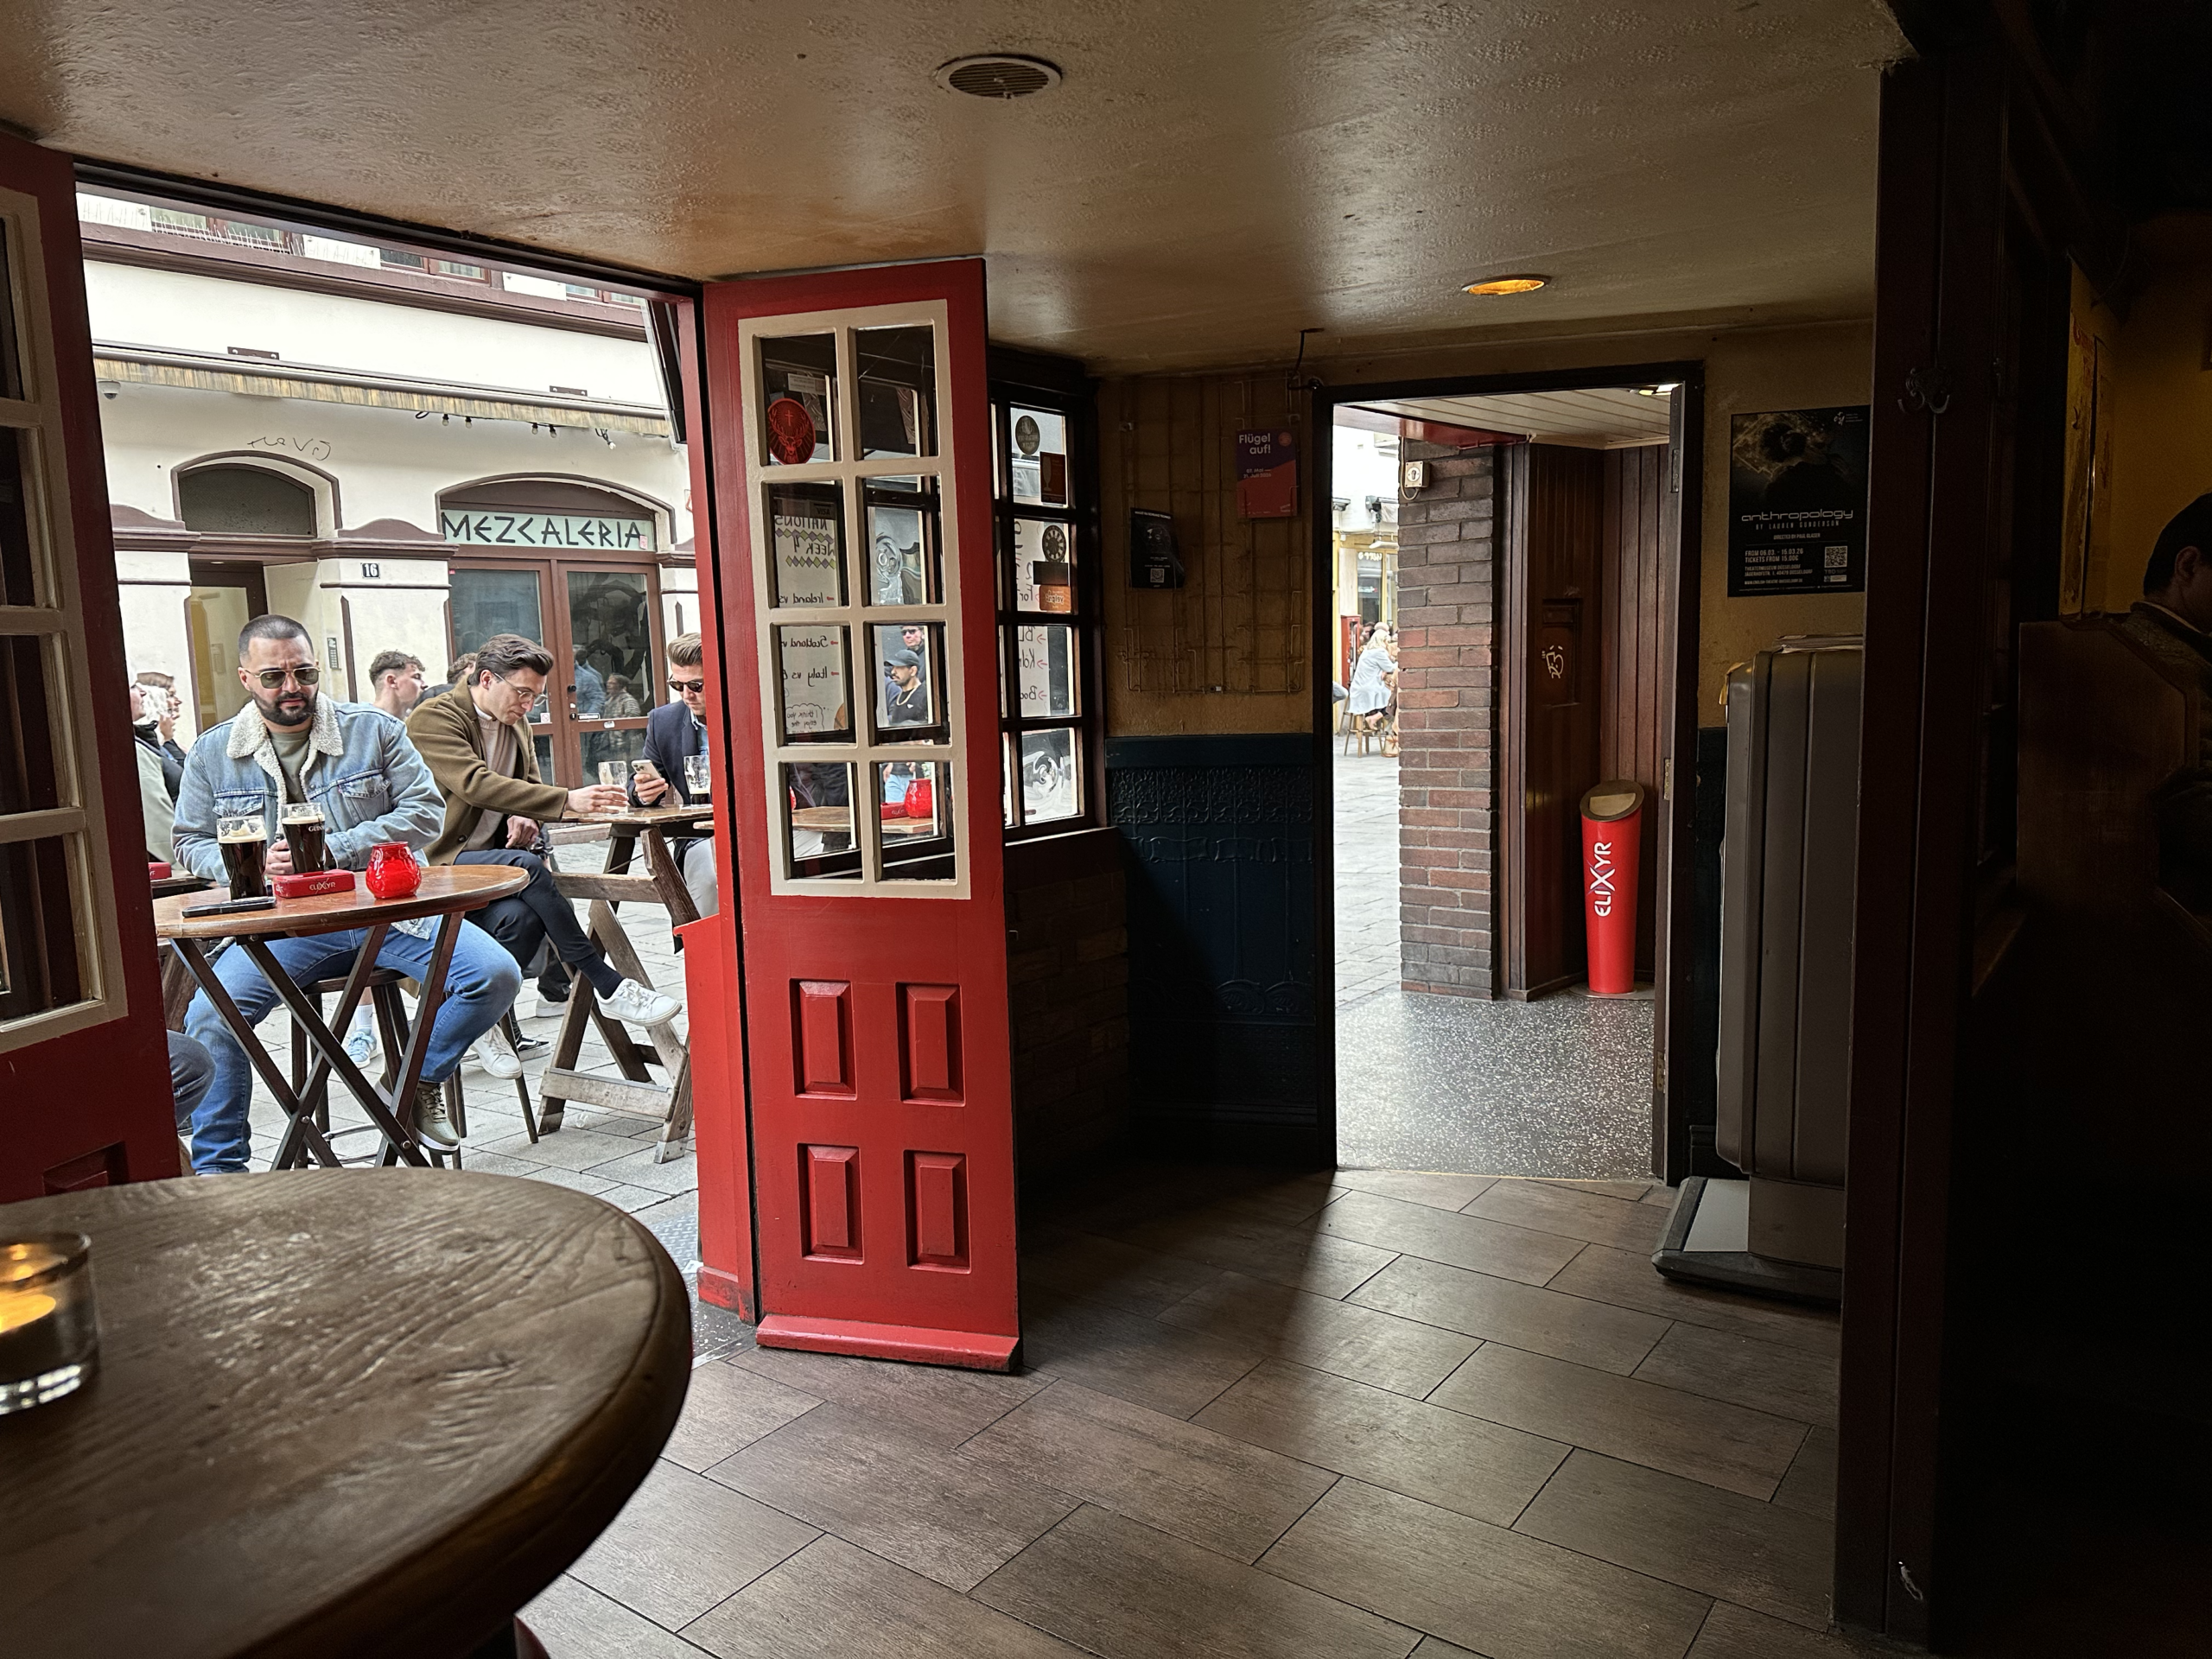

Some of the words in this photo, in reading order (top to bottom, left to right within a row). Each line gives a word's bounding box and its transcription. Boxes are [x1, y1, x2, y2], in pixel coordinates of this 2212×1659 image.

[1239, 433, 1271, 445] Flügel
[1249, 444, 1271, 454] auf!
[1741, 509, 1853, 522] anthropology
[442, 512, 643, 549] MEZCALERIA
[364, 563, 378, 577] 16
[1590, 841, 1616, 917] ELIXYR
